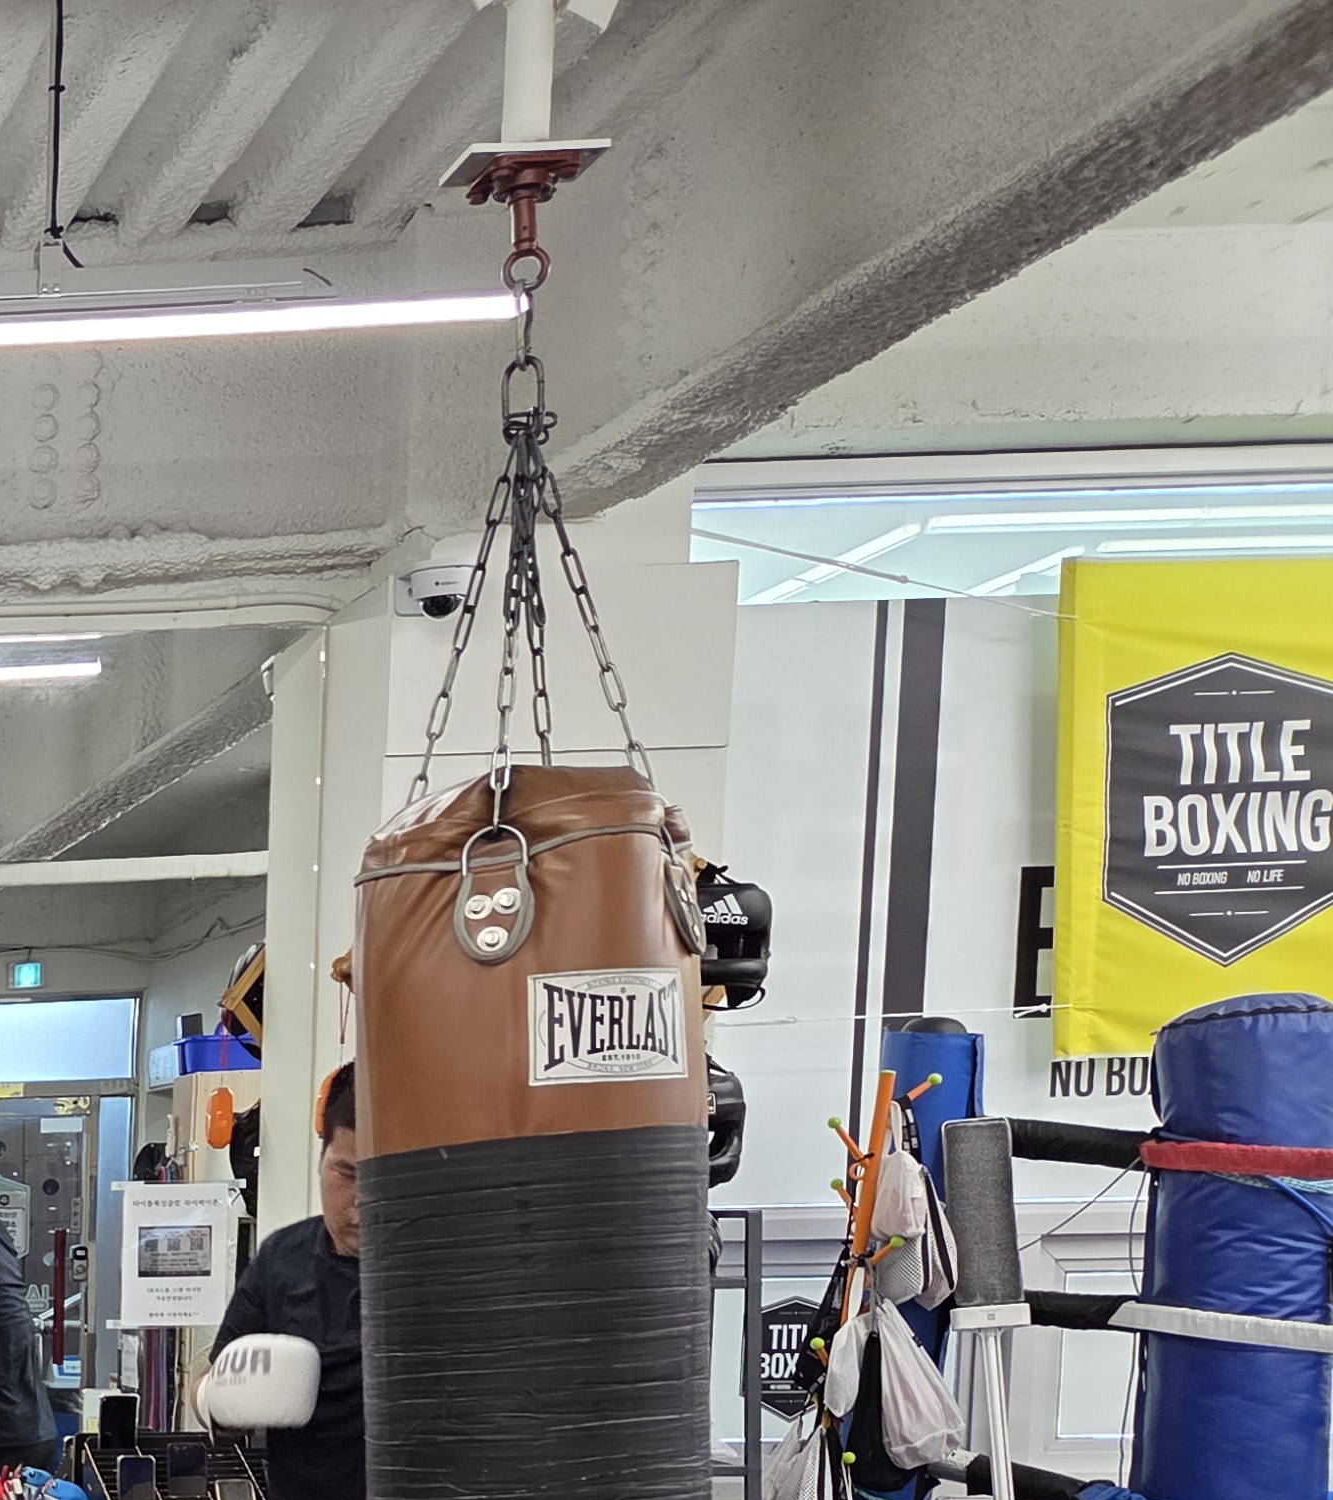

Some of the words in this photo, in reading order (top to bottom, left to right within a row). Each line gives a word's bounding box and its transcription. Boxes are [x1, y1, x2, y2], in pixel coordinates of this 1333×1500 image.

[1169, 719, 1312, 785] TITLE
[1143, 788, 1333, 857] BOXING
[1177, 874, 1190, 886] NO
[1192, 872, 1228, 885] BOXING
[1247, 870, 1261, 883] NO
[1263, 869, 1284, 883] LIFE
[701, 911, 748, 925] adidas
[543, 978, 678, 1072] EVERLAST
[1105, 1057, 1154, 1096] BO
